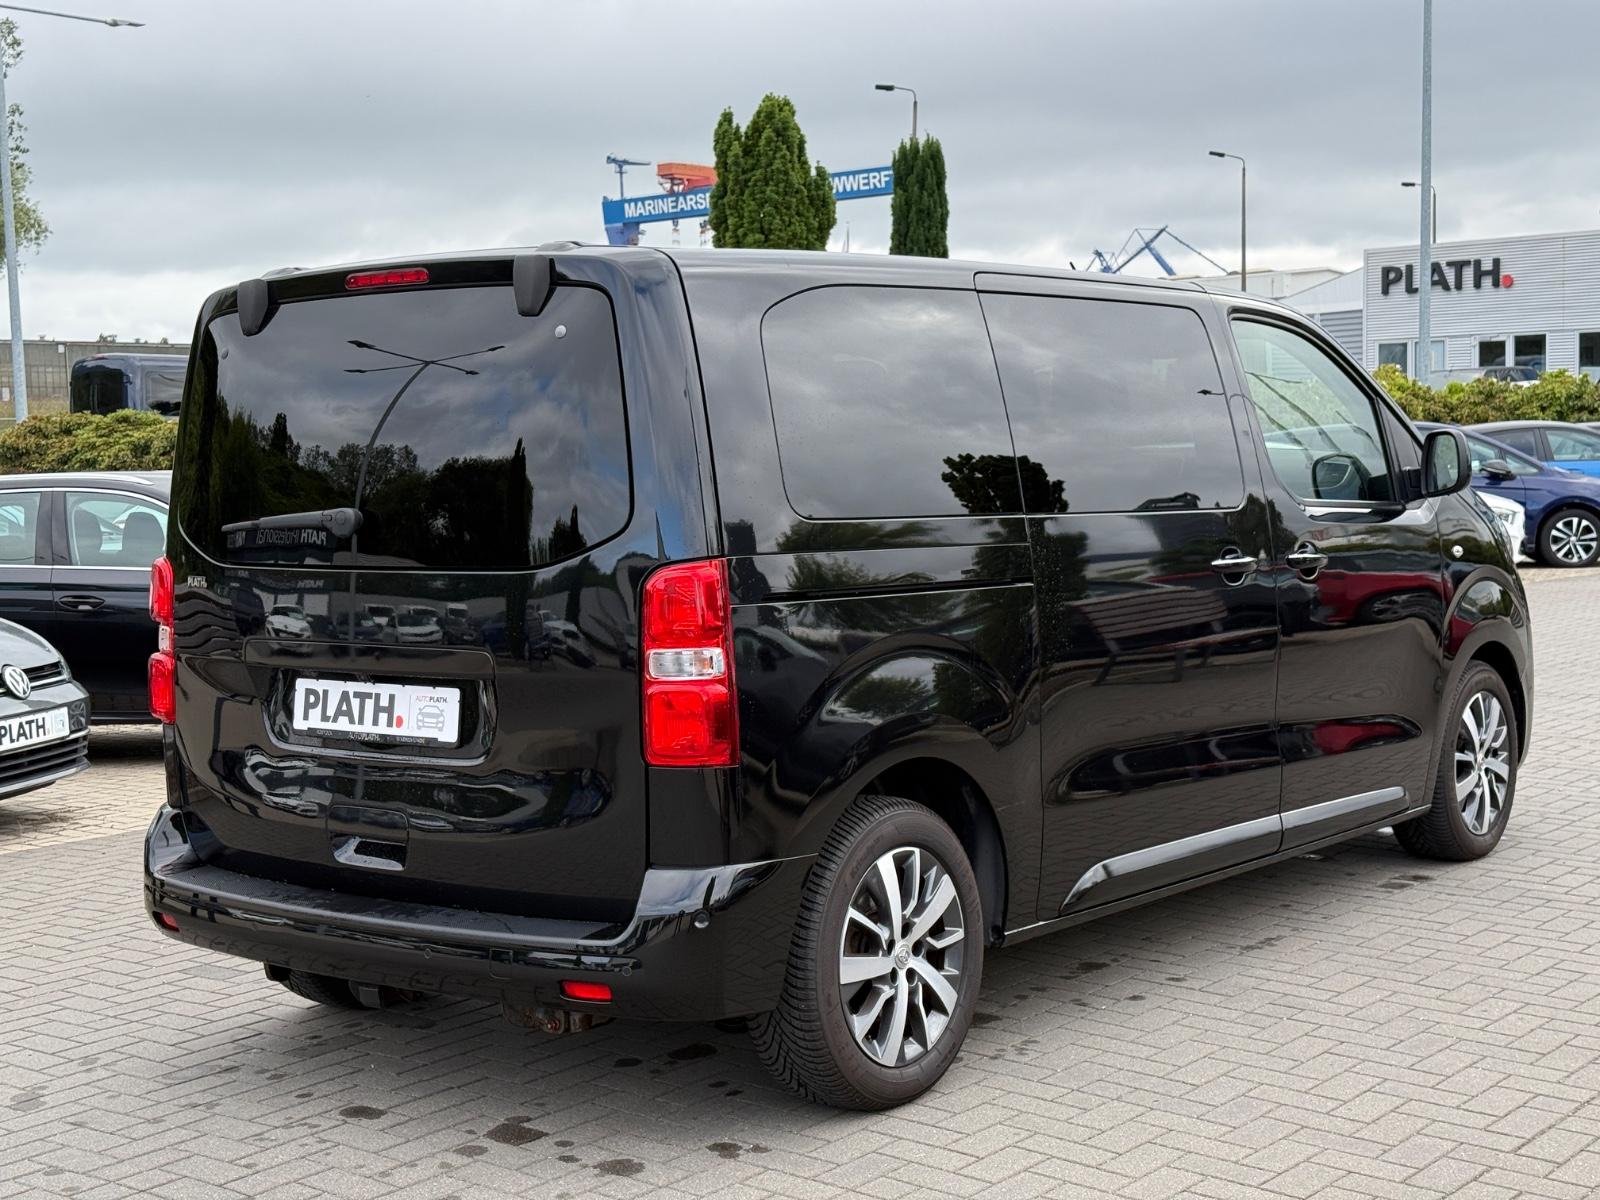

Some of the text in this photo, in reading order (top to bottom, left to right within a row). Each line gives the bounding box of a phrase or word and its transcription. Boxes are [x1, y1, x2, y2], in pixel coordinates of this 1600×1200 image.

[624, 170, 893, 219] MARINEARS WWERF
[1381, 257, 1514, 295] PLATH.
[303, 687, 404, 729] PLATH.
